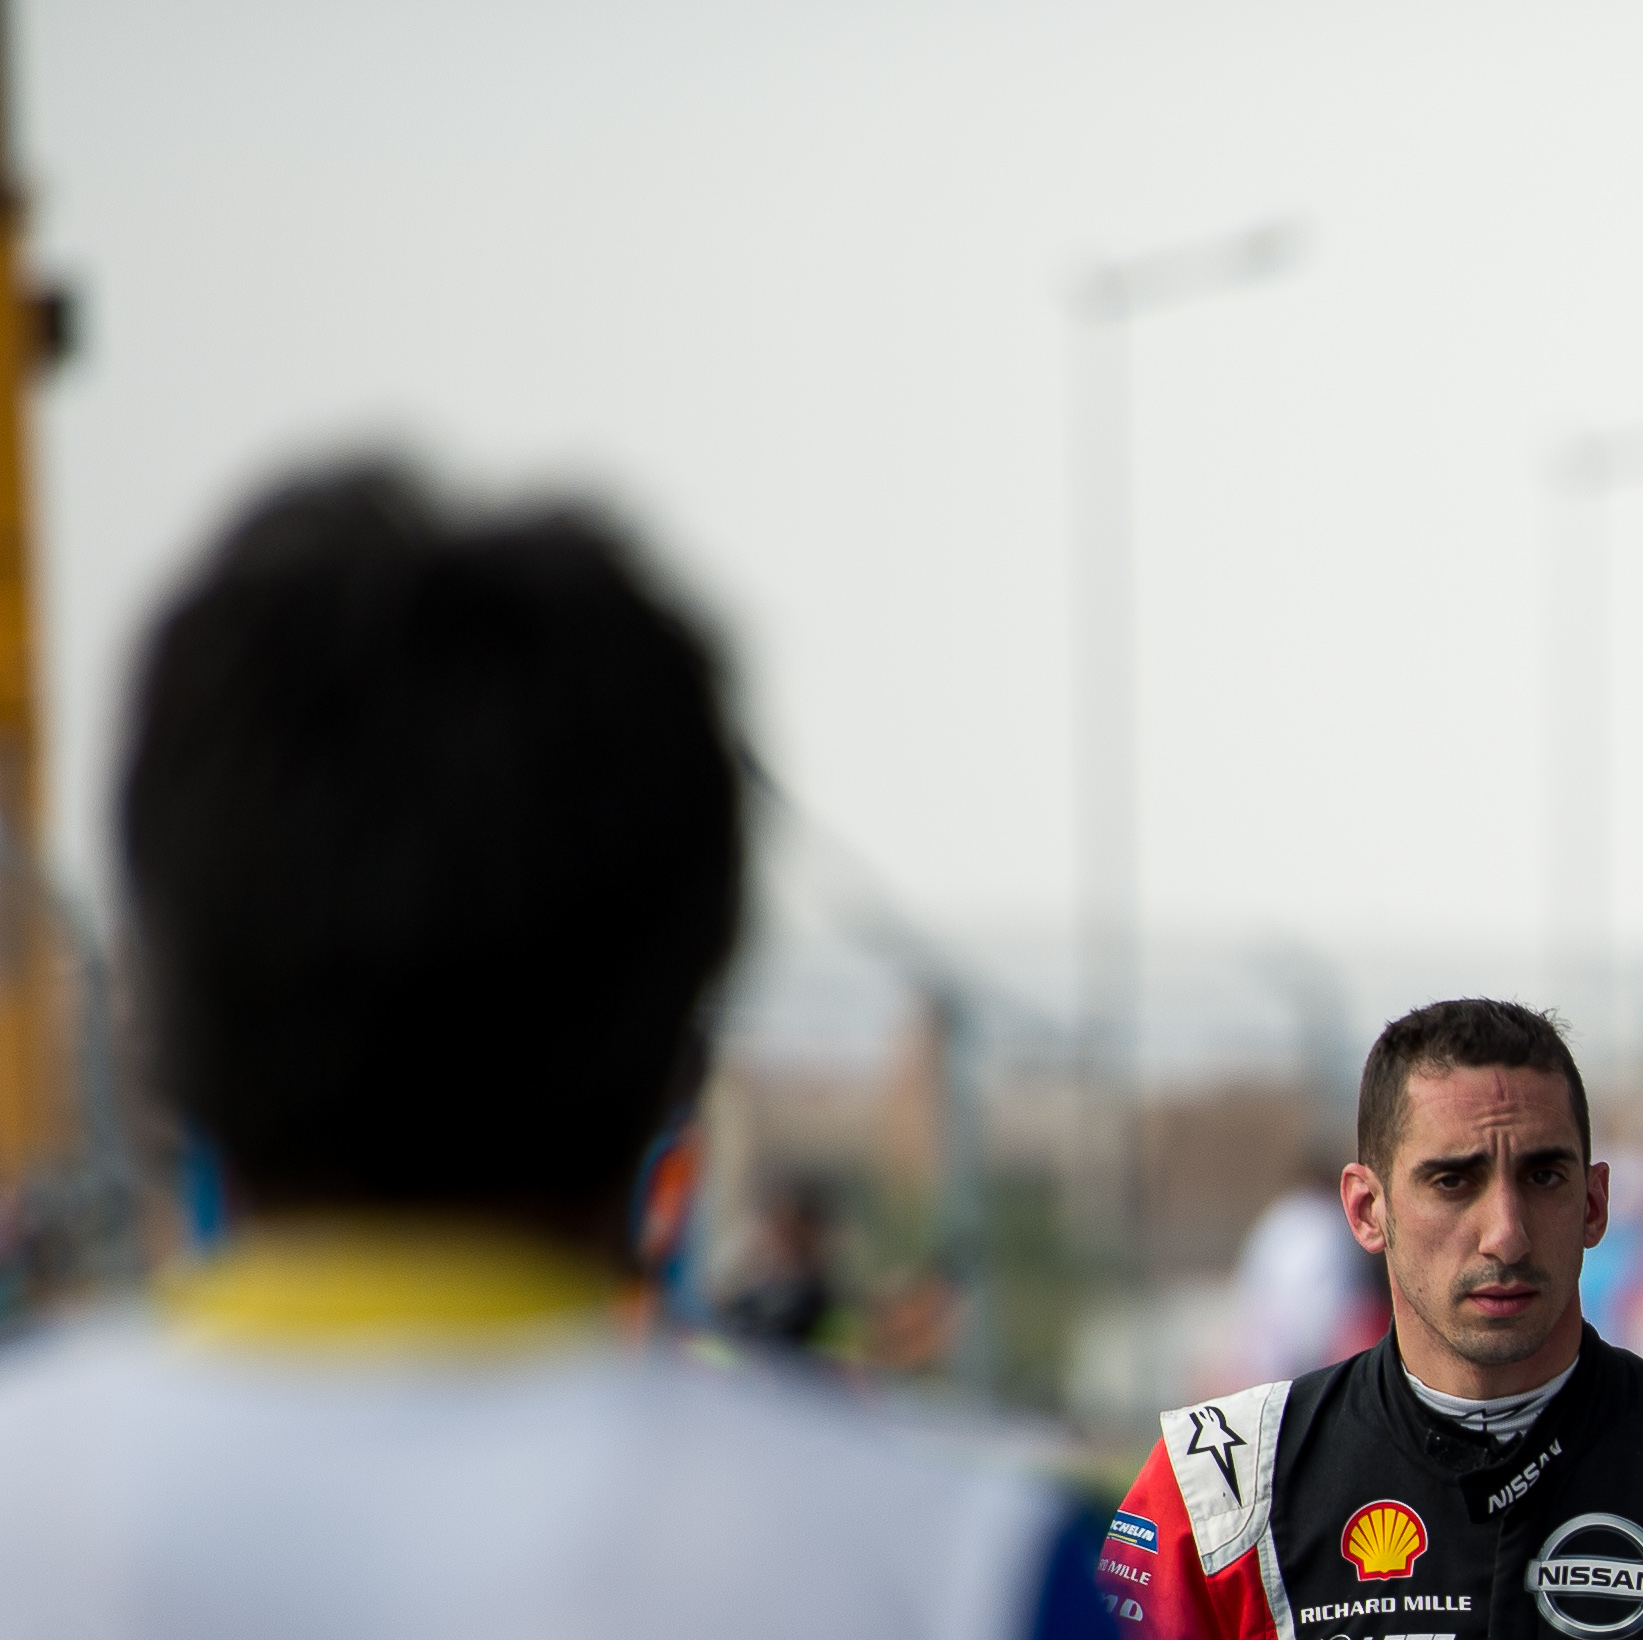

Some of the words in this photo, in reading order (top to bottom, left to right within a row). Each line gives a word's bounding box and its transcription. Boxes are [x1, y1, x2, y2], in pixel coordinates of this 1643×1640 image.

[1107, 1560, 1152, 1586] MILLE
[1300, 1597, 1396, 1624] RICHARD
[1403, 1595, 1472, 1612] MILLE
